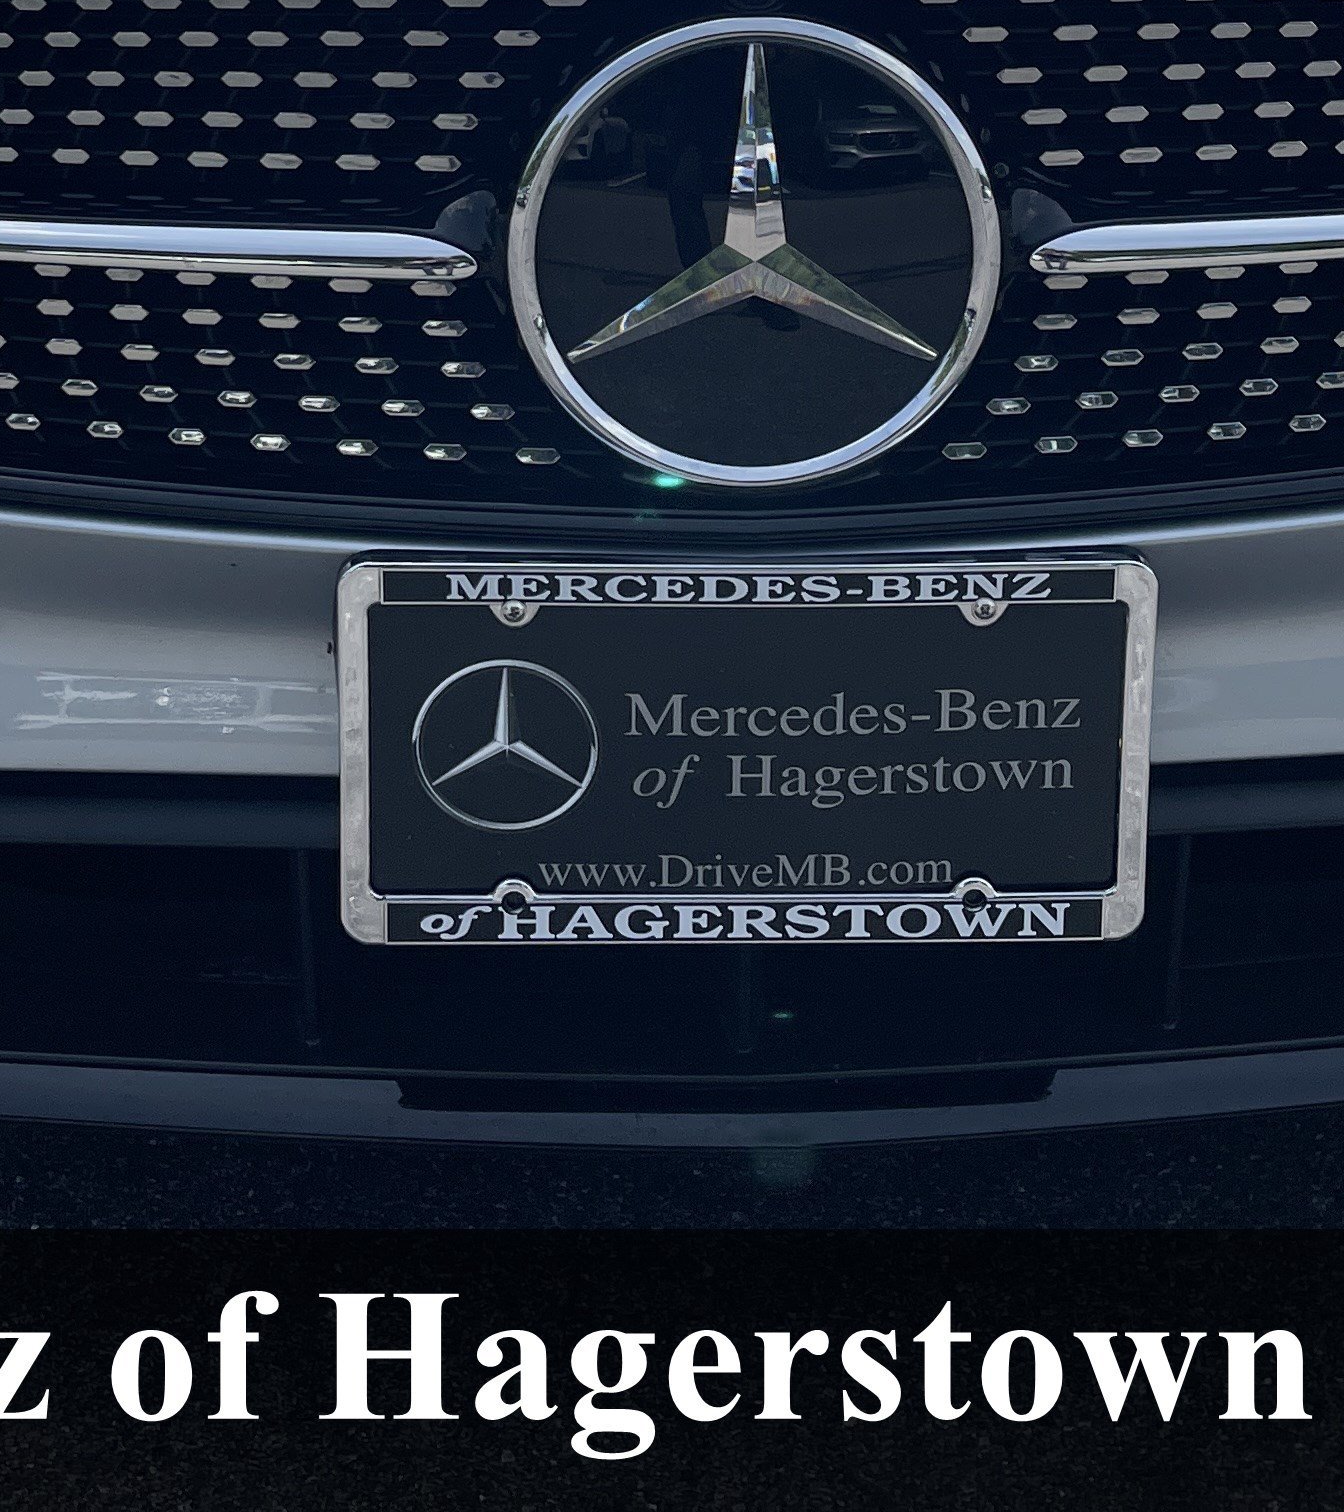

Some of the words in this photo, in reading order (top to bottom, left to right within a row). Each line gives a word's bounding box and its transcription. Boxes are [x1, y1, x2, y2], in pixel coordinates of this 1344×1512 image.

[445, 572, 1052, 603] MERCEDES-BENZ
[623, 688, 1082, 737] Mercedes-Benz
[632, 754, 700, 809] of
[725, 756, 1075, 809] Hagerstown
[538, 853, 954, 889] www.DriveMB.com
[419, 905, 492, 941] of
[497, 902, 1071, 941] HAGERSTOWN
